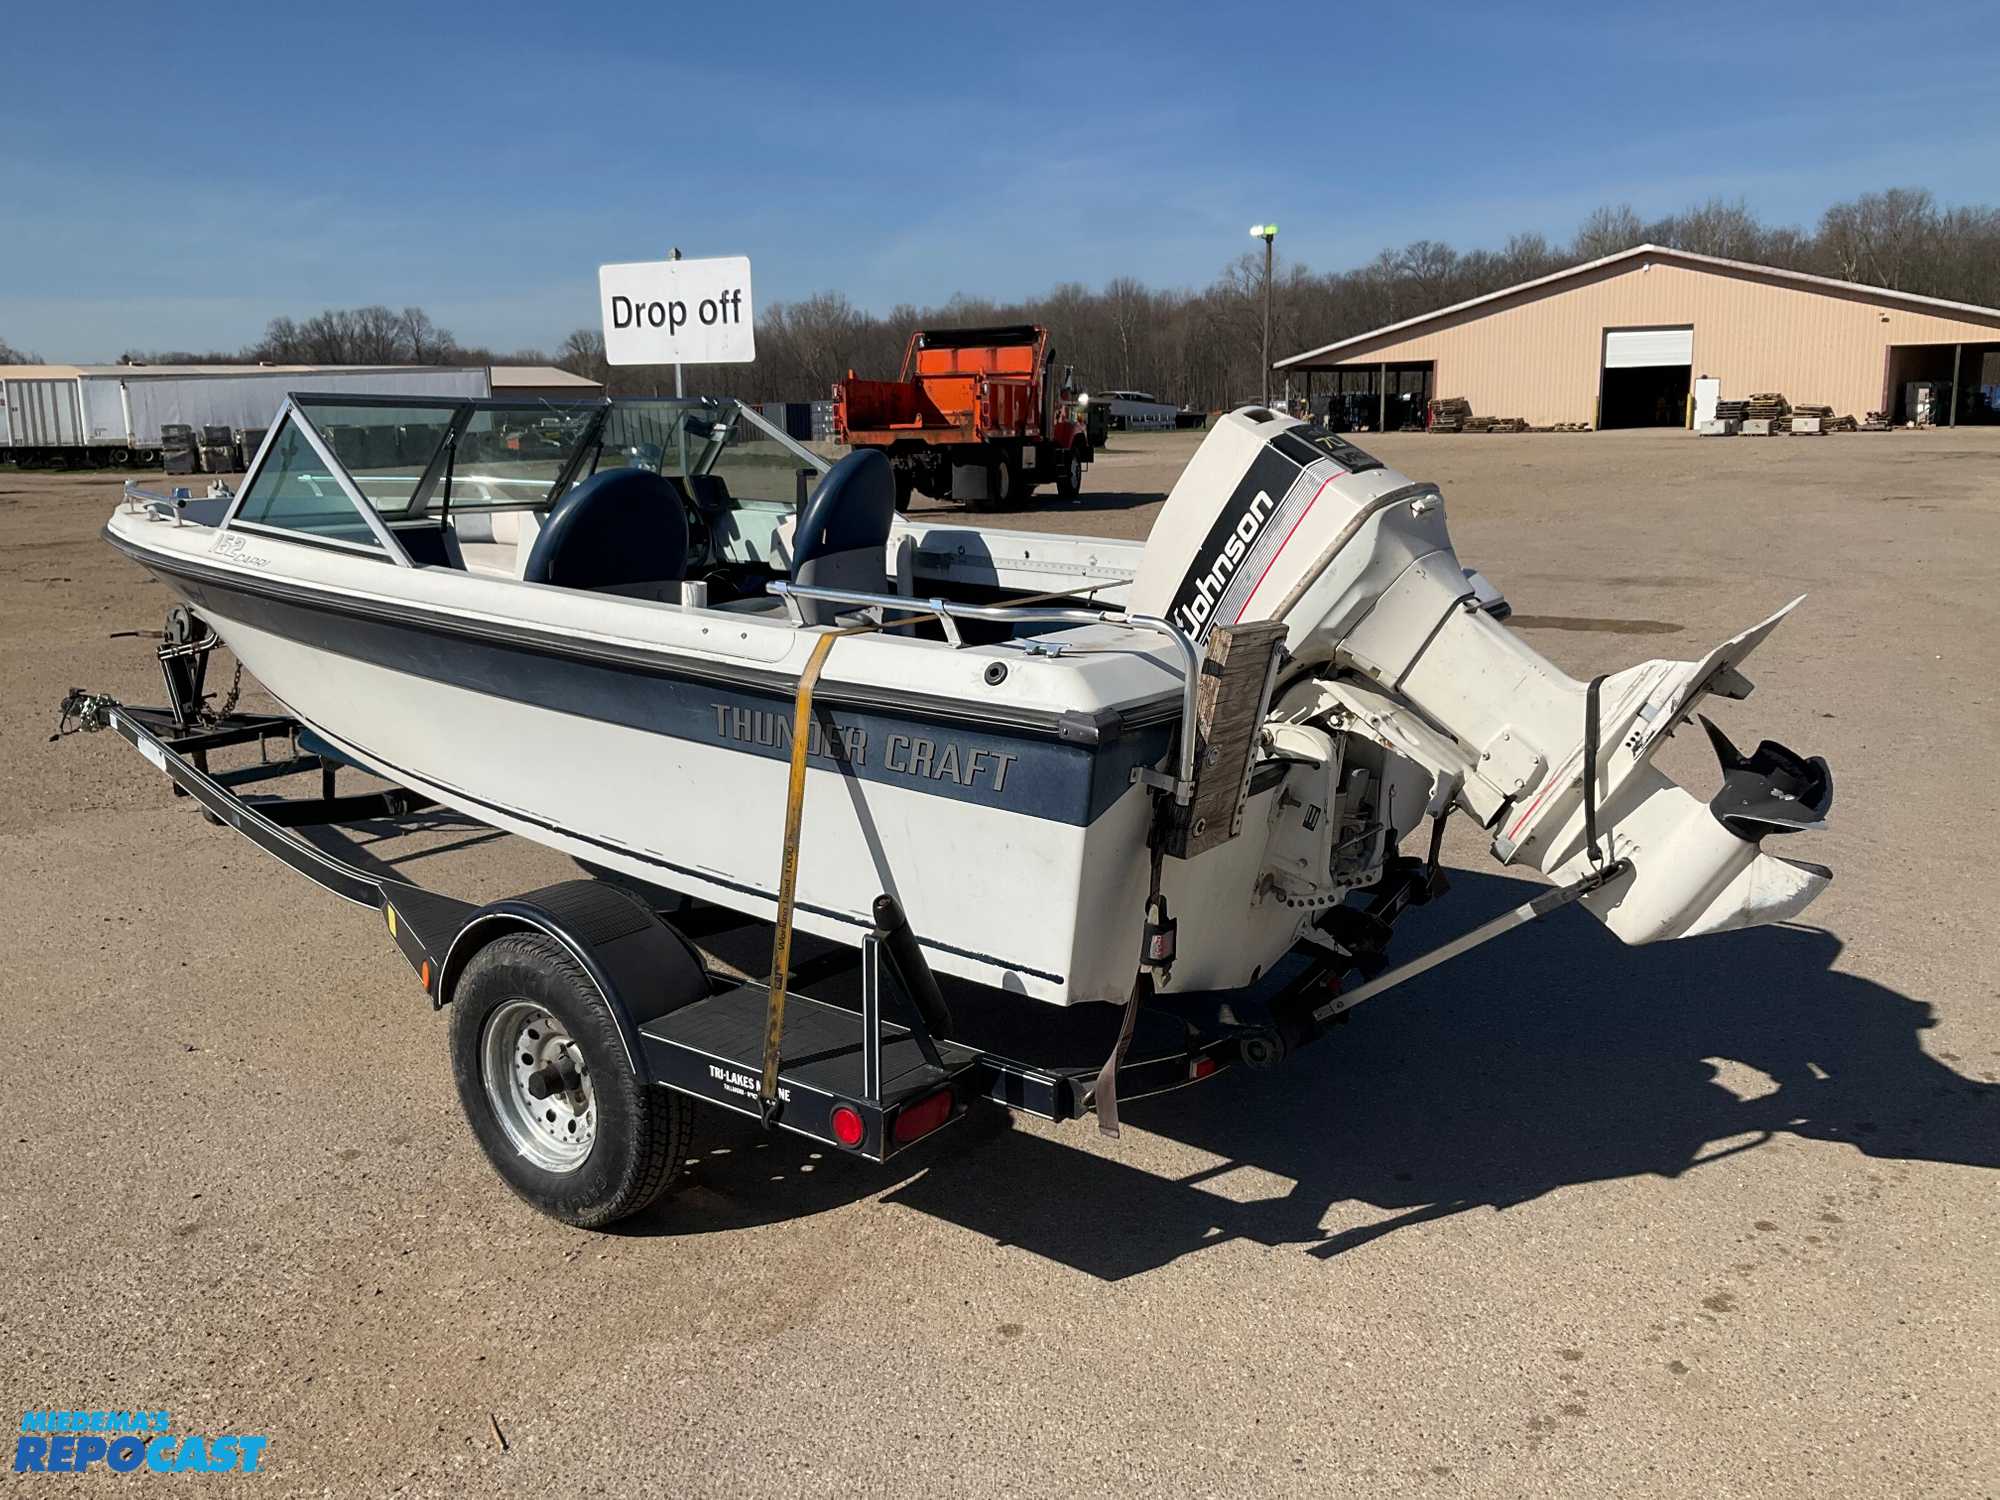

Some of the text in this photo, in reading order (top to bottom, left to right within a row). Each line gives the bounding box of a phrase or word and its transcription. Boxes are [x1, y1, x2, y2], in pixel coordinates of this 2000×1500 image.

[612, 288, 742, 336] Drop off
[1315, 436, 1347, 450] 70
[1180, 489, 1274, 641] Johnson
[710, 703, 1018, 792] THUNDER CRAFT
[755, 1079, 791, 1102] MNE
